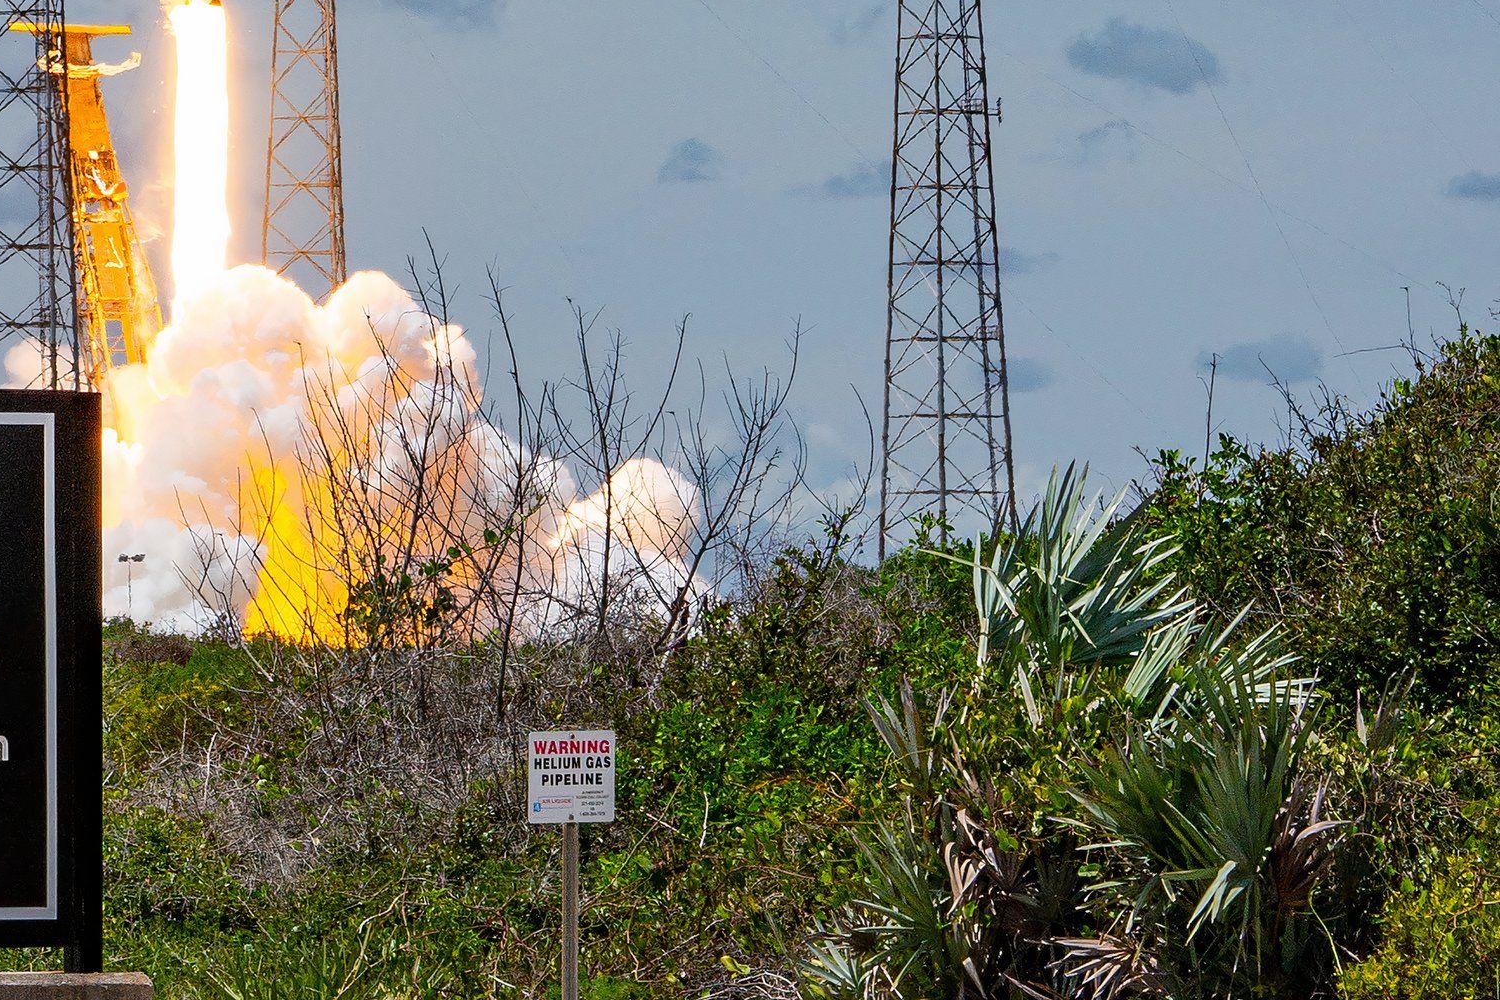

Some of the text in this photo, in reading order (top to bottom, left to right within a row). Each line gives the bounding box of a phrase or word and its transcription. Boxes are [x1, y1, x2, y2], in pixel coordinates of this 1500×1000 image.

[534, 740, 610, 754] WARNING
[534, 756, 611, 769] HELIUM GAS
[541, 773, 603, 786] PIPELINE
